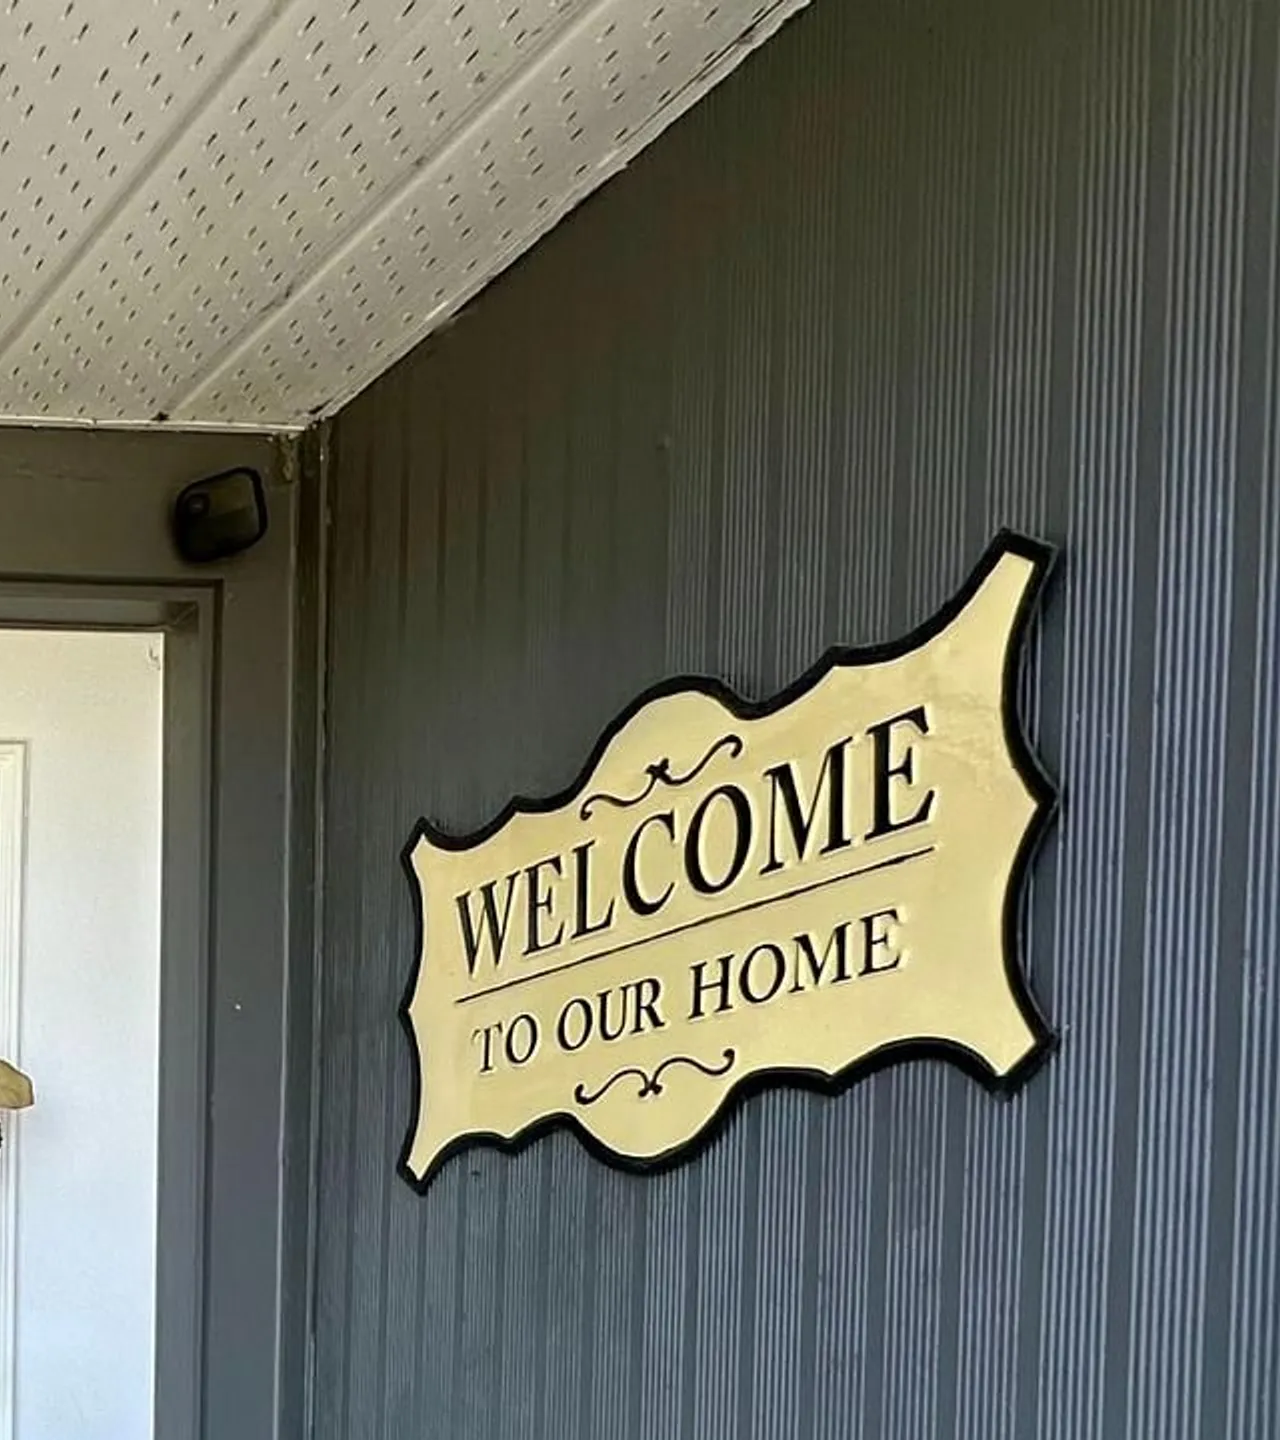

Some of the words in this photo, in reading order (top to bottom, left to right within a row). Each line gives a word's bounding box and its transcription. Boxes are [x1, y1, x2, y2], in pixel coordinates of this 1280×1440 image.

[456, 705, 936, 977] WELCOME
[471, 1013, 537, 1075] TO
[557, 977, 665, 1052] OUR
[688, 907, 902, 1019] HOME
